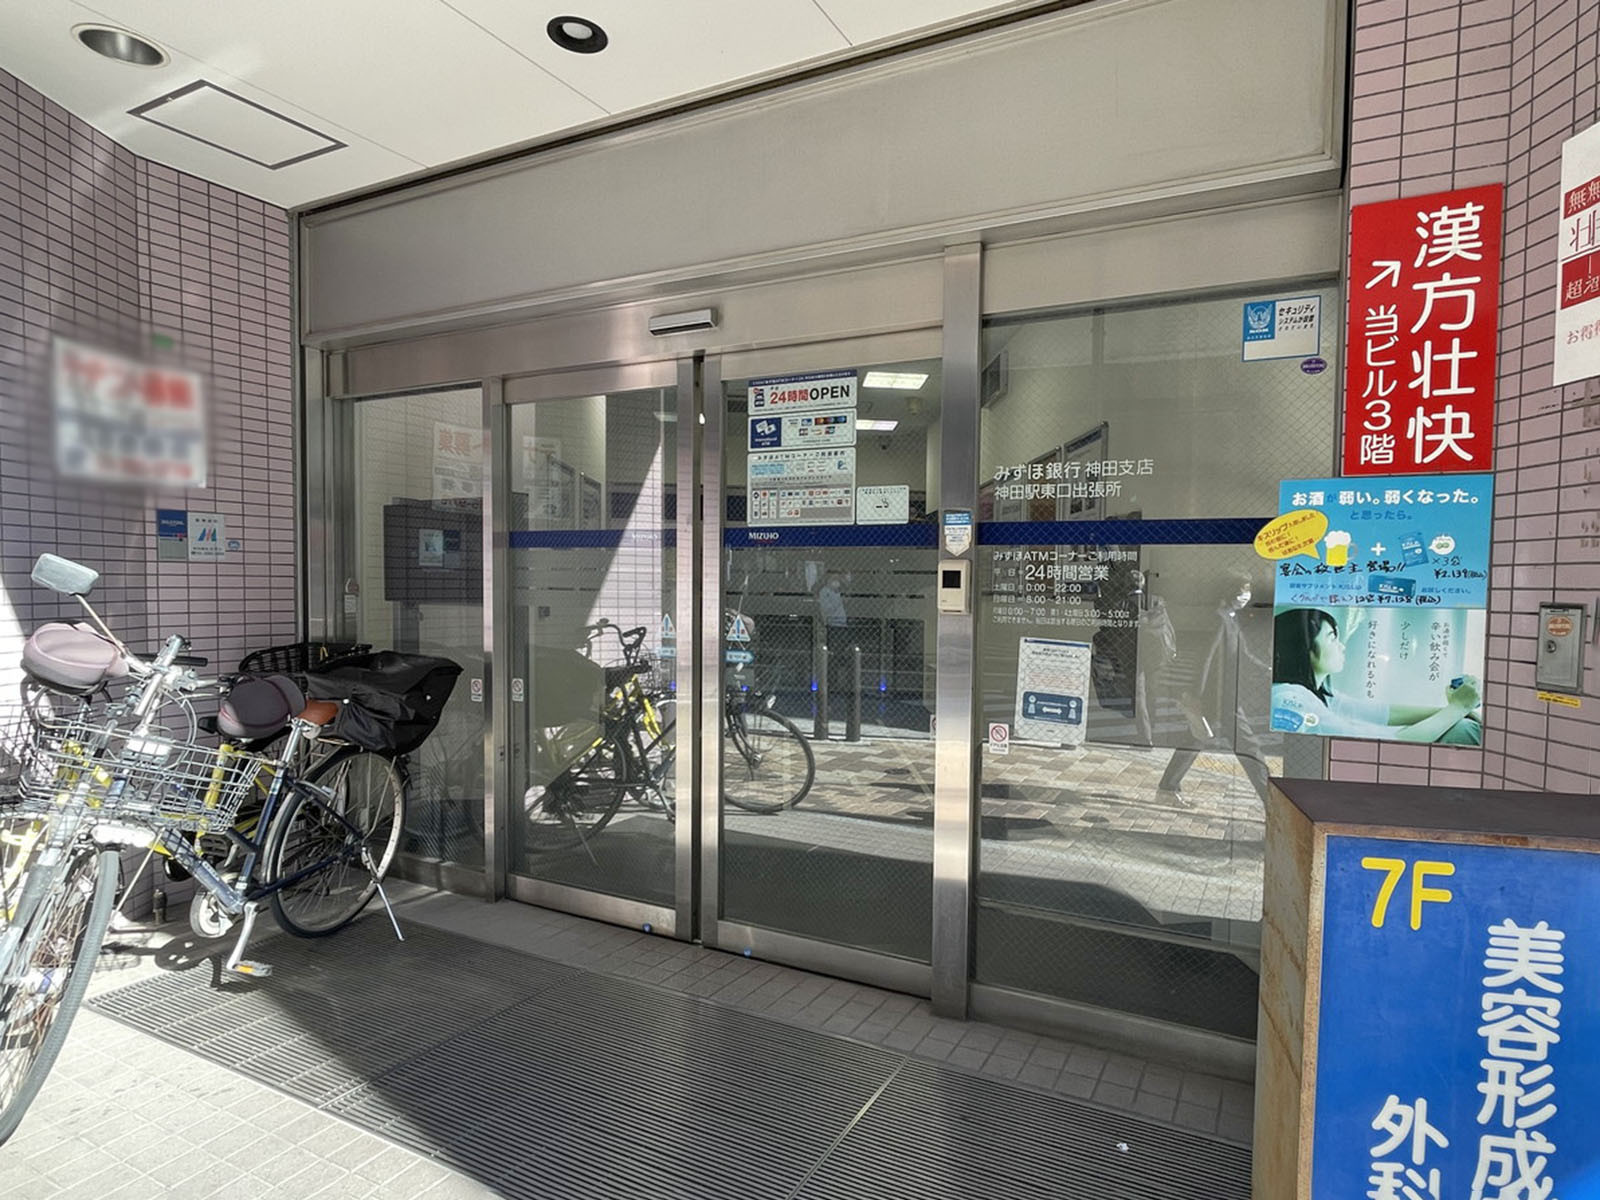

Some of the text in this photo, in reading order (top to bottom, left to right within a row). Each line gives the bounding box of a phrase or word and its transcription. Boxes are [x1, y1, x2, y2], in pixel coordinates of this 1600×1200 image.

[1405, 202, 1484, 464] 漢方壮快
[1360, 304, 1399, 465] 当ビル3階
[993, 458, 1154, 481] みずほ銀行 神田支店
[993, 480, 1122, 501] 神田駅東口出張所
[748, 532, 780, 540] MIZUHO
[1350, 509, 1413, 522] と思ったら。
[1025, 564, 1110, 581] 24時間営業
[1366, 620, 1377, 699] 好きになれるかも
[1400, 621, 1411, 661] 少しだけ
[1429, 621, 1441, 682] 辛い飲み会が
[1360, 857, 1456, 931] 7F
[1470, 917, 1566, 1200] 美容形成
